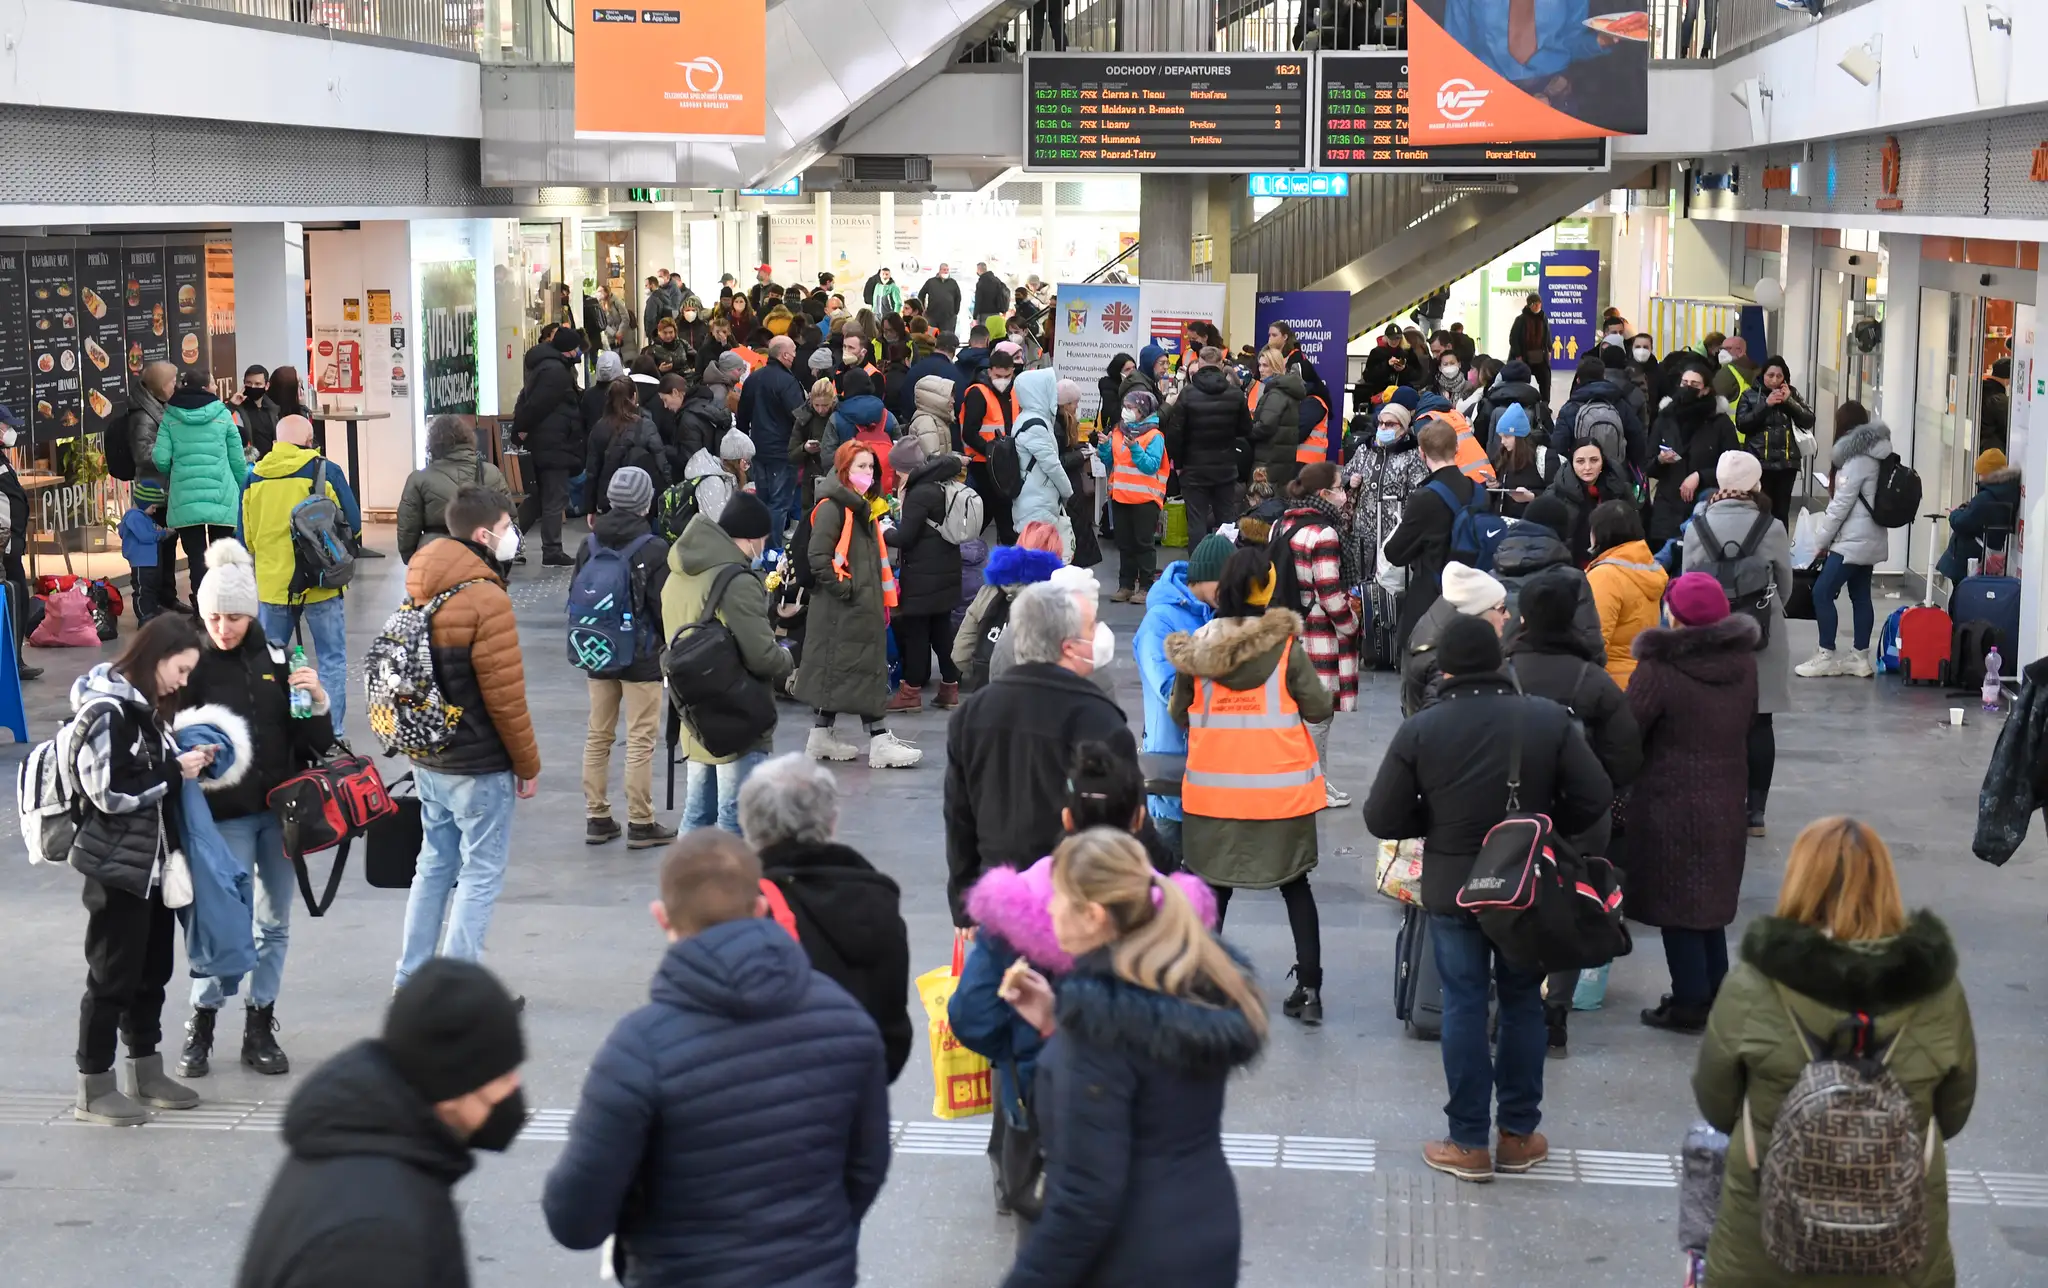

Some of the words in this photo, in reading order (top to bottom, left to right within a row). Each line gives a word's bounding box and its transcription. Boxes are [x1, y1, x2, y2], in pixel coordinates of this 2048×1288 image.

[624, 14, 635, 22] Play
[1106, 66, 1156, 75] ODCHODY
[1158, 66, 1164, 76] /
[1165, 66, 1231, 75] DEPARTURES
[1276, 65, 1300, 75] 16:21
[1036, 90, 1057, 99] 16:27
[1061, 90, 1077, 99] REX
[1328, 90, 1351, 99] 17:13
[1354, 90, 1366, 99] Os
[1374, 91, 1392, 99] ZSSK
[1036, 105, 1057, 114] 16:32
[1101, 105, 1136, 114] Moldava
[1149, 105, 1185, 114] B-mesto
[1275, 105, 1281, 114] 3
[1328, 105, 1351, 114] 17:17
[1354, 105, 1366, 114] Os
[1374, 106, 1392, 114] ZSSK
[1036, 120, 1057, 129] 16:36
[1275, 120, 1281, 129] 3
[1328, 120, 1351, 129] 17:23
[1354, 120, 1366, 129] RR
[1374, 121, 1392, 129] ZSSK
[1036, 135, 1057, 144] 17:01
[1061, 135, 1077, 144] REX
[1101, 135, 1141, 144] Humenné
[1328, 135, 1351, 144] 17:36
[1354, 135, 1366, 144] Os
[1373, 136, 1391, 144] ZSSK
[1036, 150, 1057, 159] 17:12
[1061, 150, 1077, 159] REX
[1101, 149, 1156, 159] Poprad-Tatry
[1328, 150, 1351, 159] 17:57
[1354, 150, 1366, 159] RR
[1373, 151, 1391, 159] ZSSK
[1396, 150, 1428, 159] Trenčín
[1486, 150, 1536, 159] Poprad-Tatry
[1293, 183, 1308, 192] WC
[1281, 319, 1322, 328] ОПОМОГА
[426, 303, 473, 361] VITAJTE
[1058, 340, 1098, 348] ГУМАНІТАРНА
[1066, 351, 1111, 359] HUMANITARIAN
[430, 377, 436, 408] V
[43, 478, 136, 535] CAPPUCCIN
